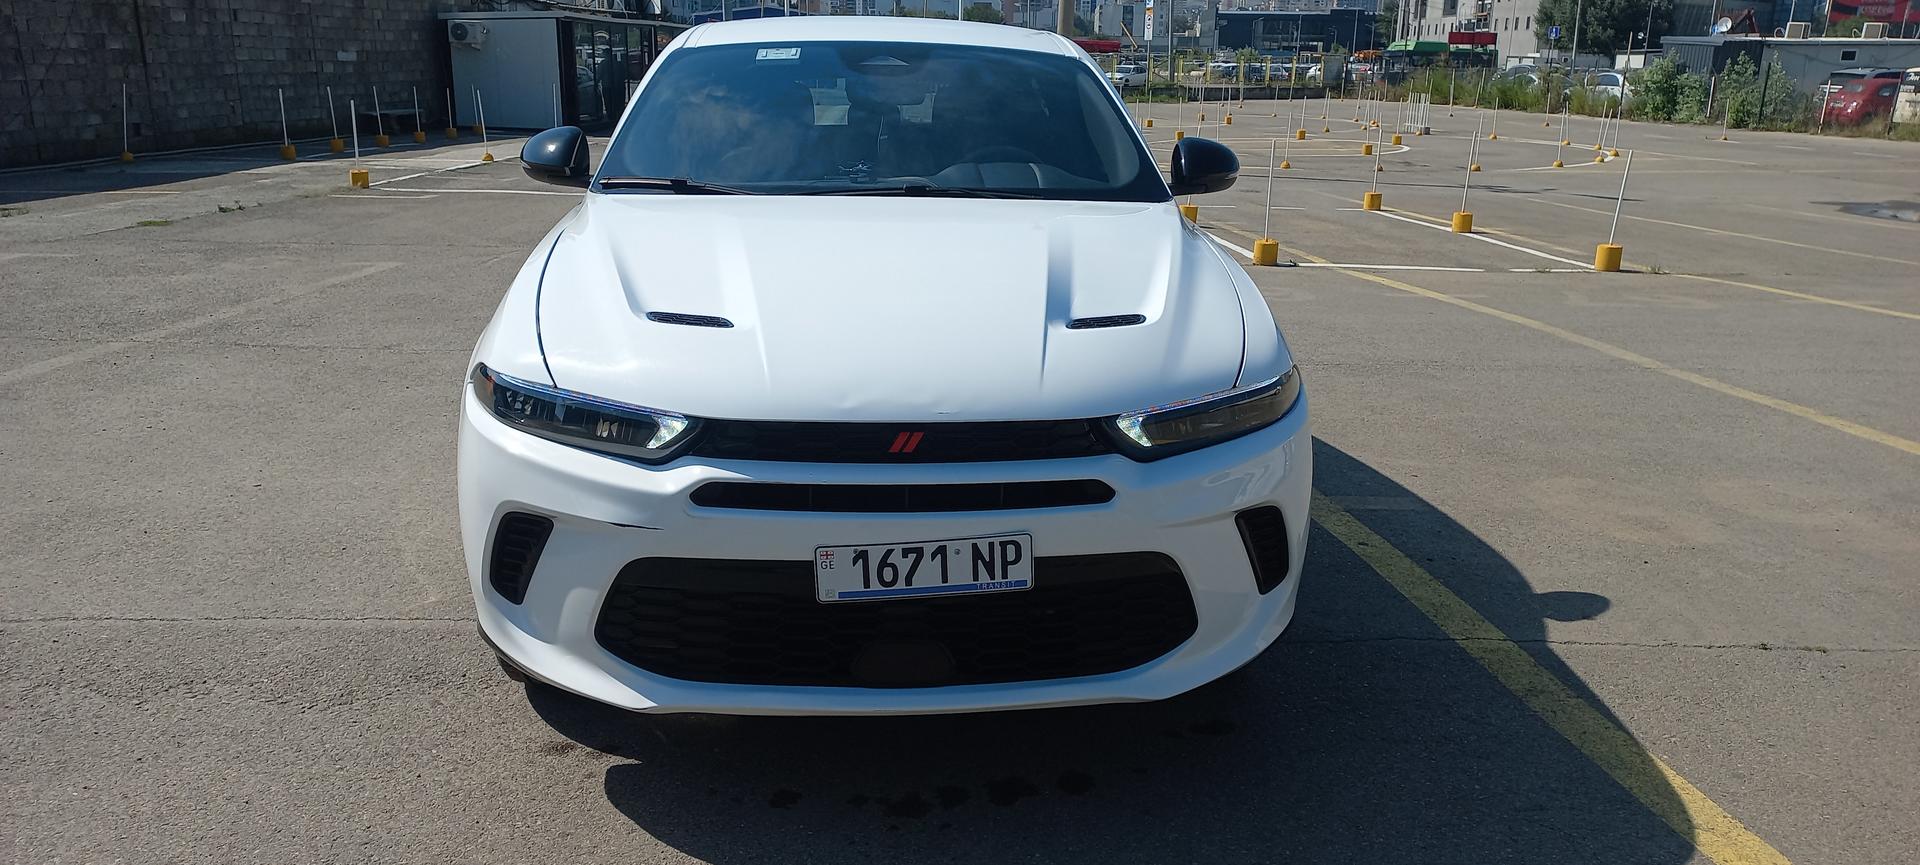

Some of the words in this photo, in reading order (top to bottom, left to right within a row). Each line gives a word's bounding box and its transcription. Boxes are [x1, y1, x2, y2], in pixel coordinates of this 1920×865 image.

[820, 560, 835, 570] GE
[852, 544, 949, 589] 1671
[971, 539, 1023, 582] NP
[976, 580, 1017, 590] TRANSIT
